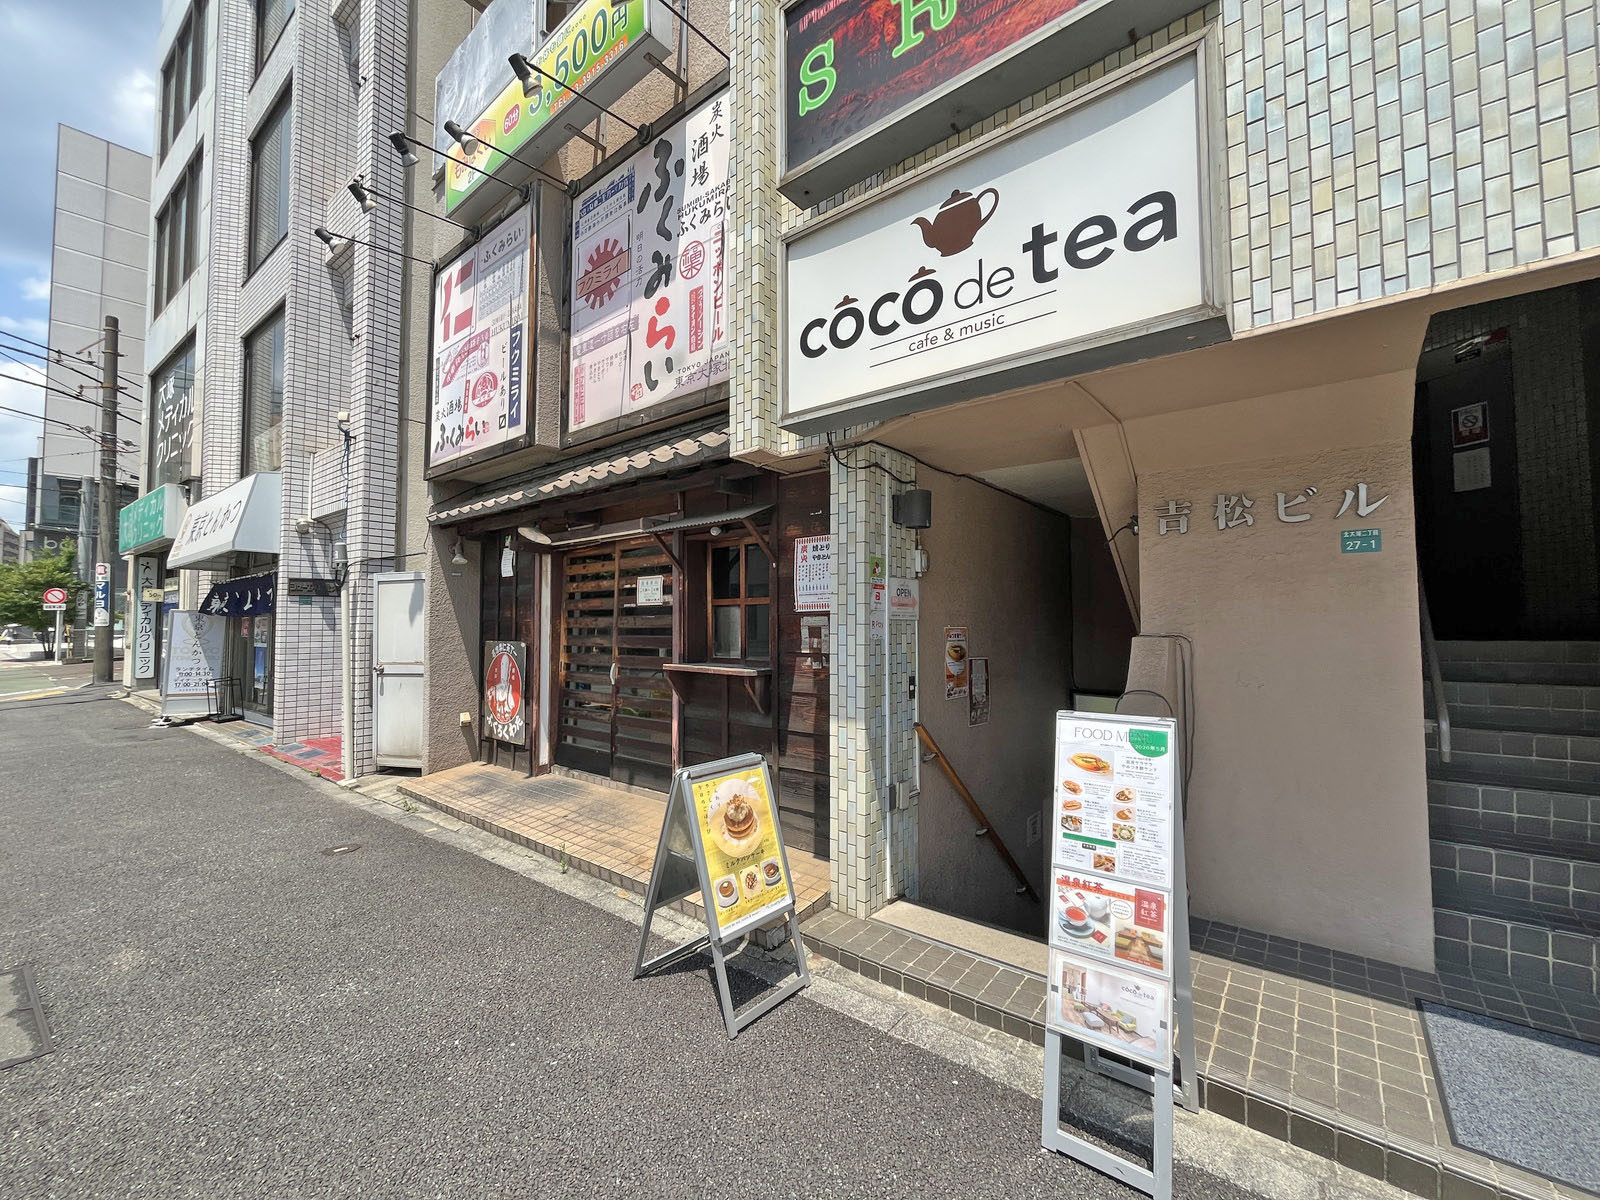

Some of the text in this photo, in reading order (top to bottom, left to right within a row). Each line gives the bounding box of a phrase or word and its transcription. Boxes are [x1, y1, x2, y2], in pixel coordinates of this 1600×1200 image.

[798, 38, 837, 117] S
[691, 132, 709, 187] 酒場
[1022, 191, 1178, 284] tea
[577, 257, 622, 296] フクミライ
[637, 138, 685, 392] ふくみらい
[799, 258, 1015, 359] coco de
[908, 312, 1006, 353] cafe & music
[157, 376, 176, 409] 大塚
[509, 330, 521, 419] フクミライ
[677, 361, 702, 375] TOKYO
[156, 384, 194, 439] メディカル
[156, 420, 194, 469] クリニック
[186, 500, 242, 546] 東京とんかつ
[1154, 482, 1390, 536] 吉松ビル
[1346, 539, 1376, 550] 27-1
[896, 587, 912, 598] OPEN
[138, 577, 153, 674] 大ディカルクリニック
[191, 615, 205, 664] 東京とんかつ
[1073, 726, 1113, 741] FOOD
